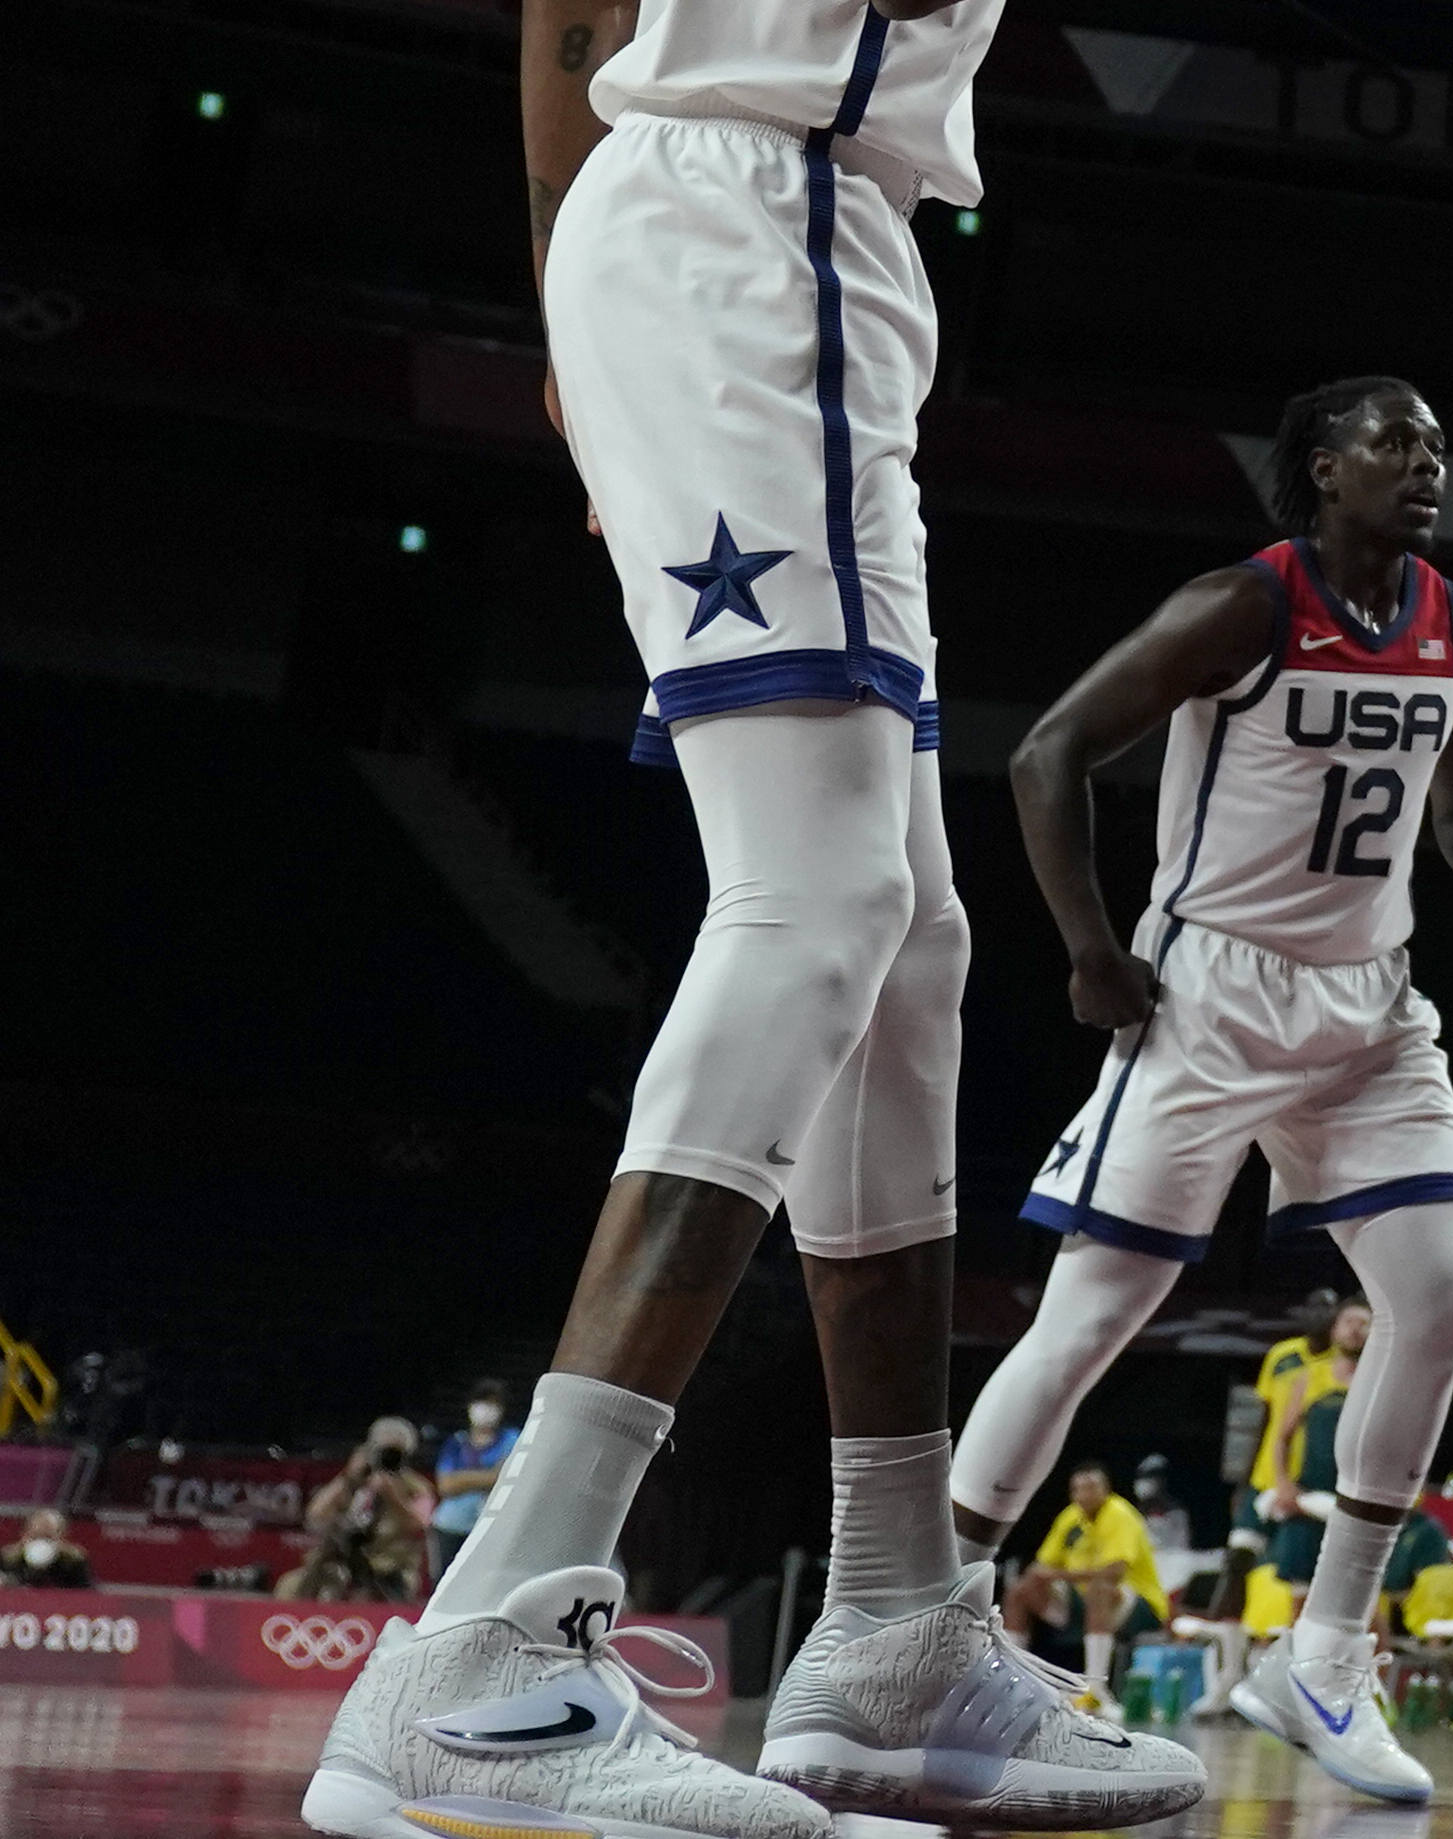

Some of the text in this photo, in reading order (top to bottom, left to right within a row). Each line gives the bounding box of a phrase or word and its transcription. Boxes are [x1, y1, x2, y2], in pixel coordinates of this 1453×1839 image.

[1285, 687, 1448, 752] USA
[1307, 764, 1406, 878] 12
[43, 1613, 140, 1655] 2020
